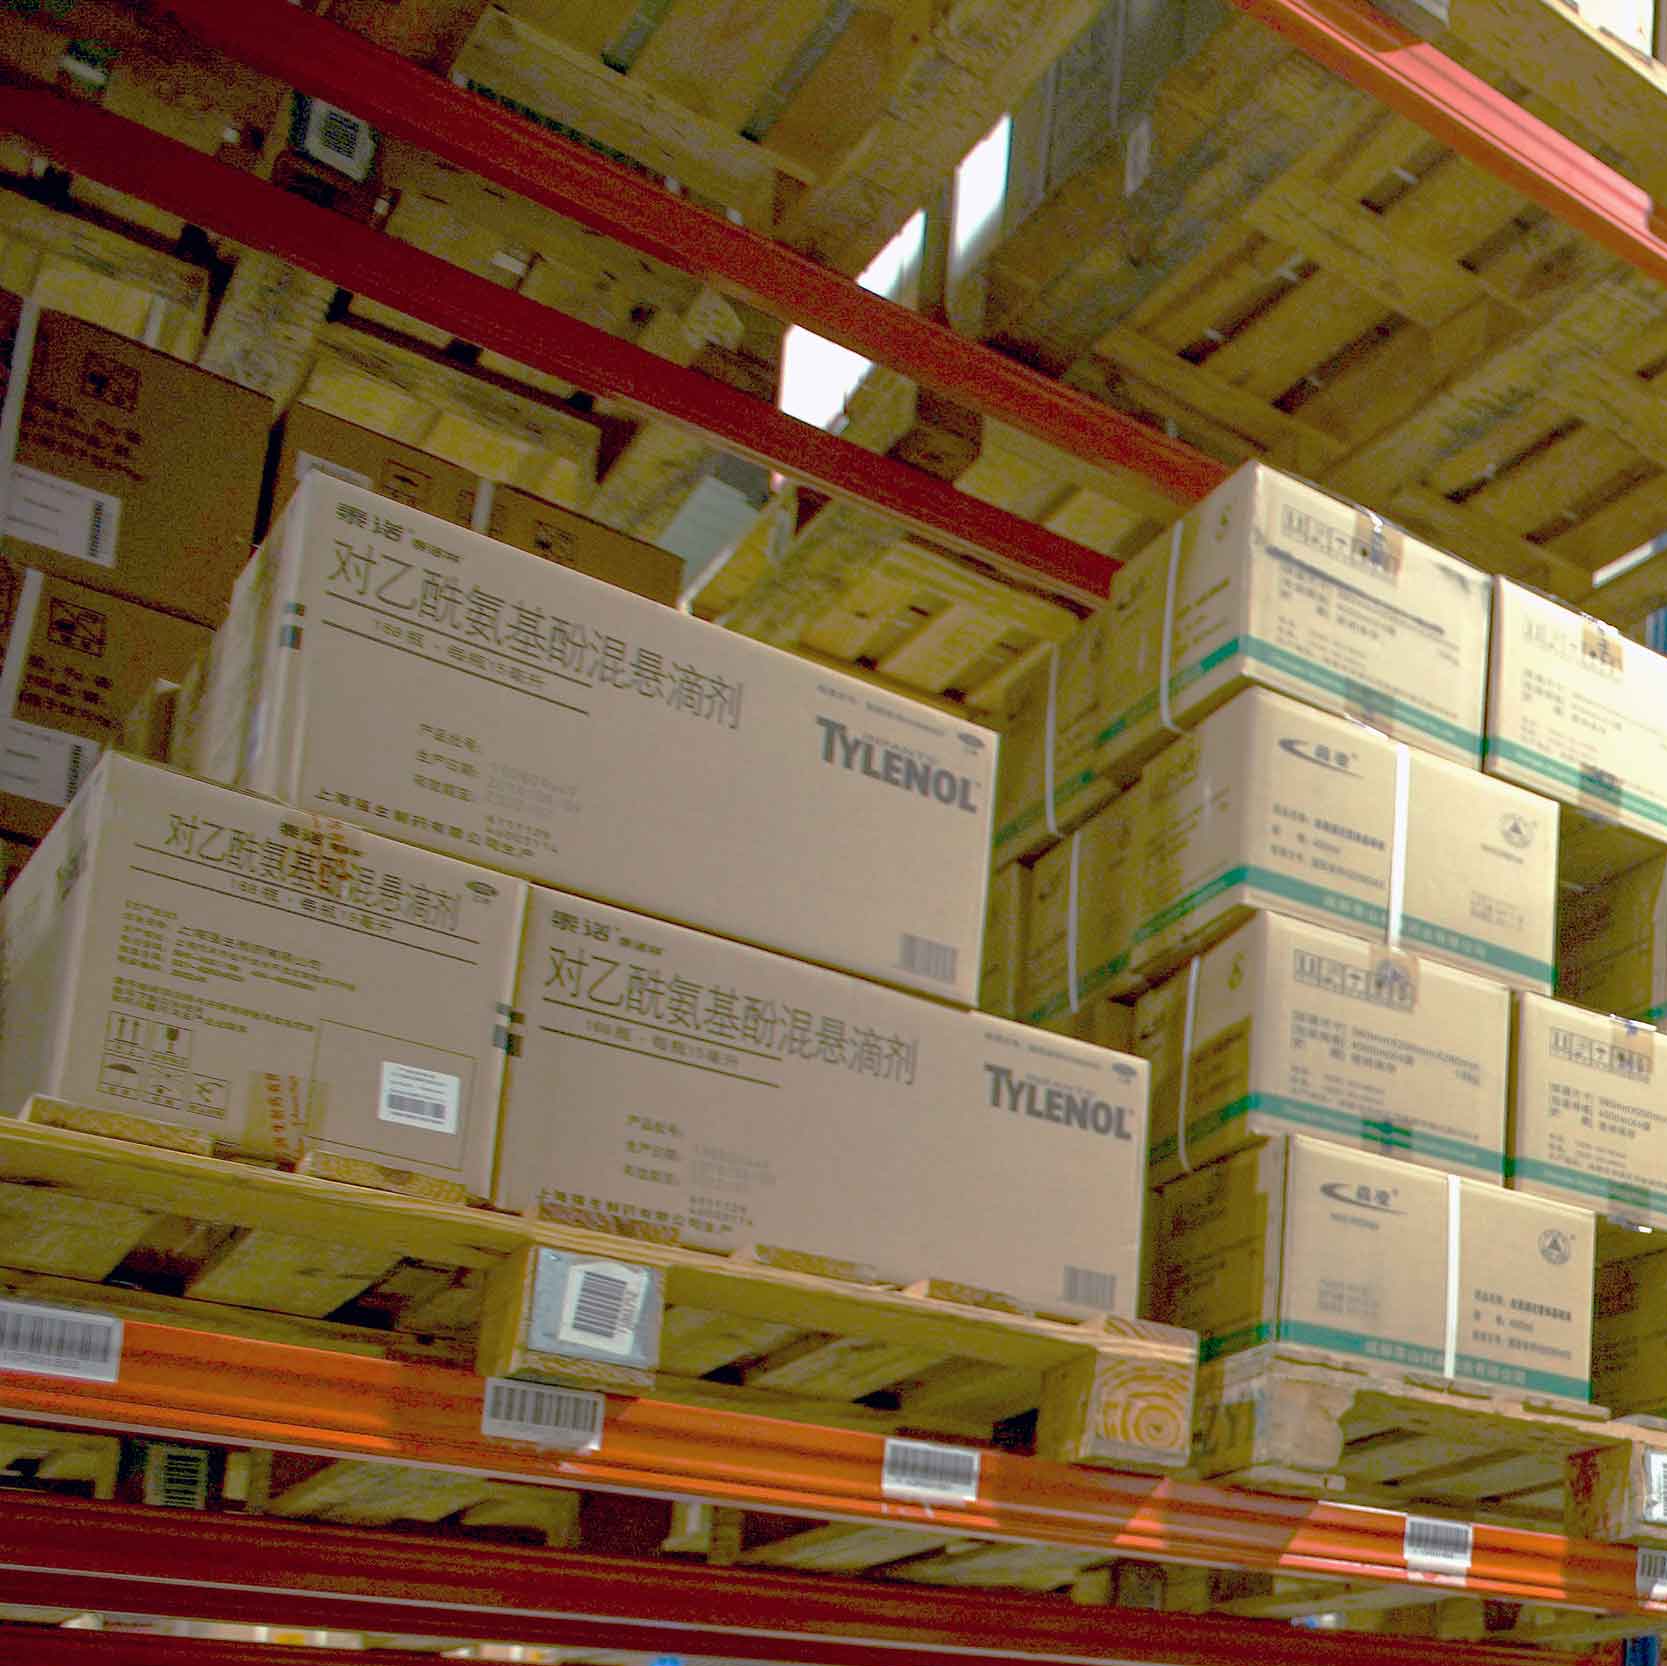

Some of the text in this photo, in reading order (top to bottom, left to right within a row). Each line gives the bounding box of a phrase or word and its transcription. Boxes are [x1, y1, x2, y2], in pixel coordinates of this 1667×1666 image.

[327, 538, 745, 730] 对乙酰氨基酚混悬滴剂
[815, 714, 979, 814] TYLENOL
[542, 945, 920, 1088] 对乙酰氨基酚混悬滴剂
[984, 1062, 1134, 1142] TYLENOL
